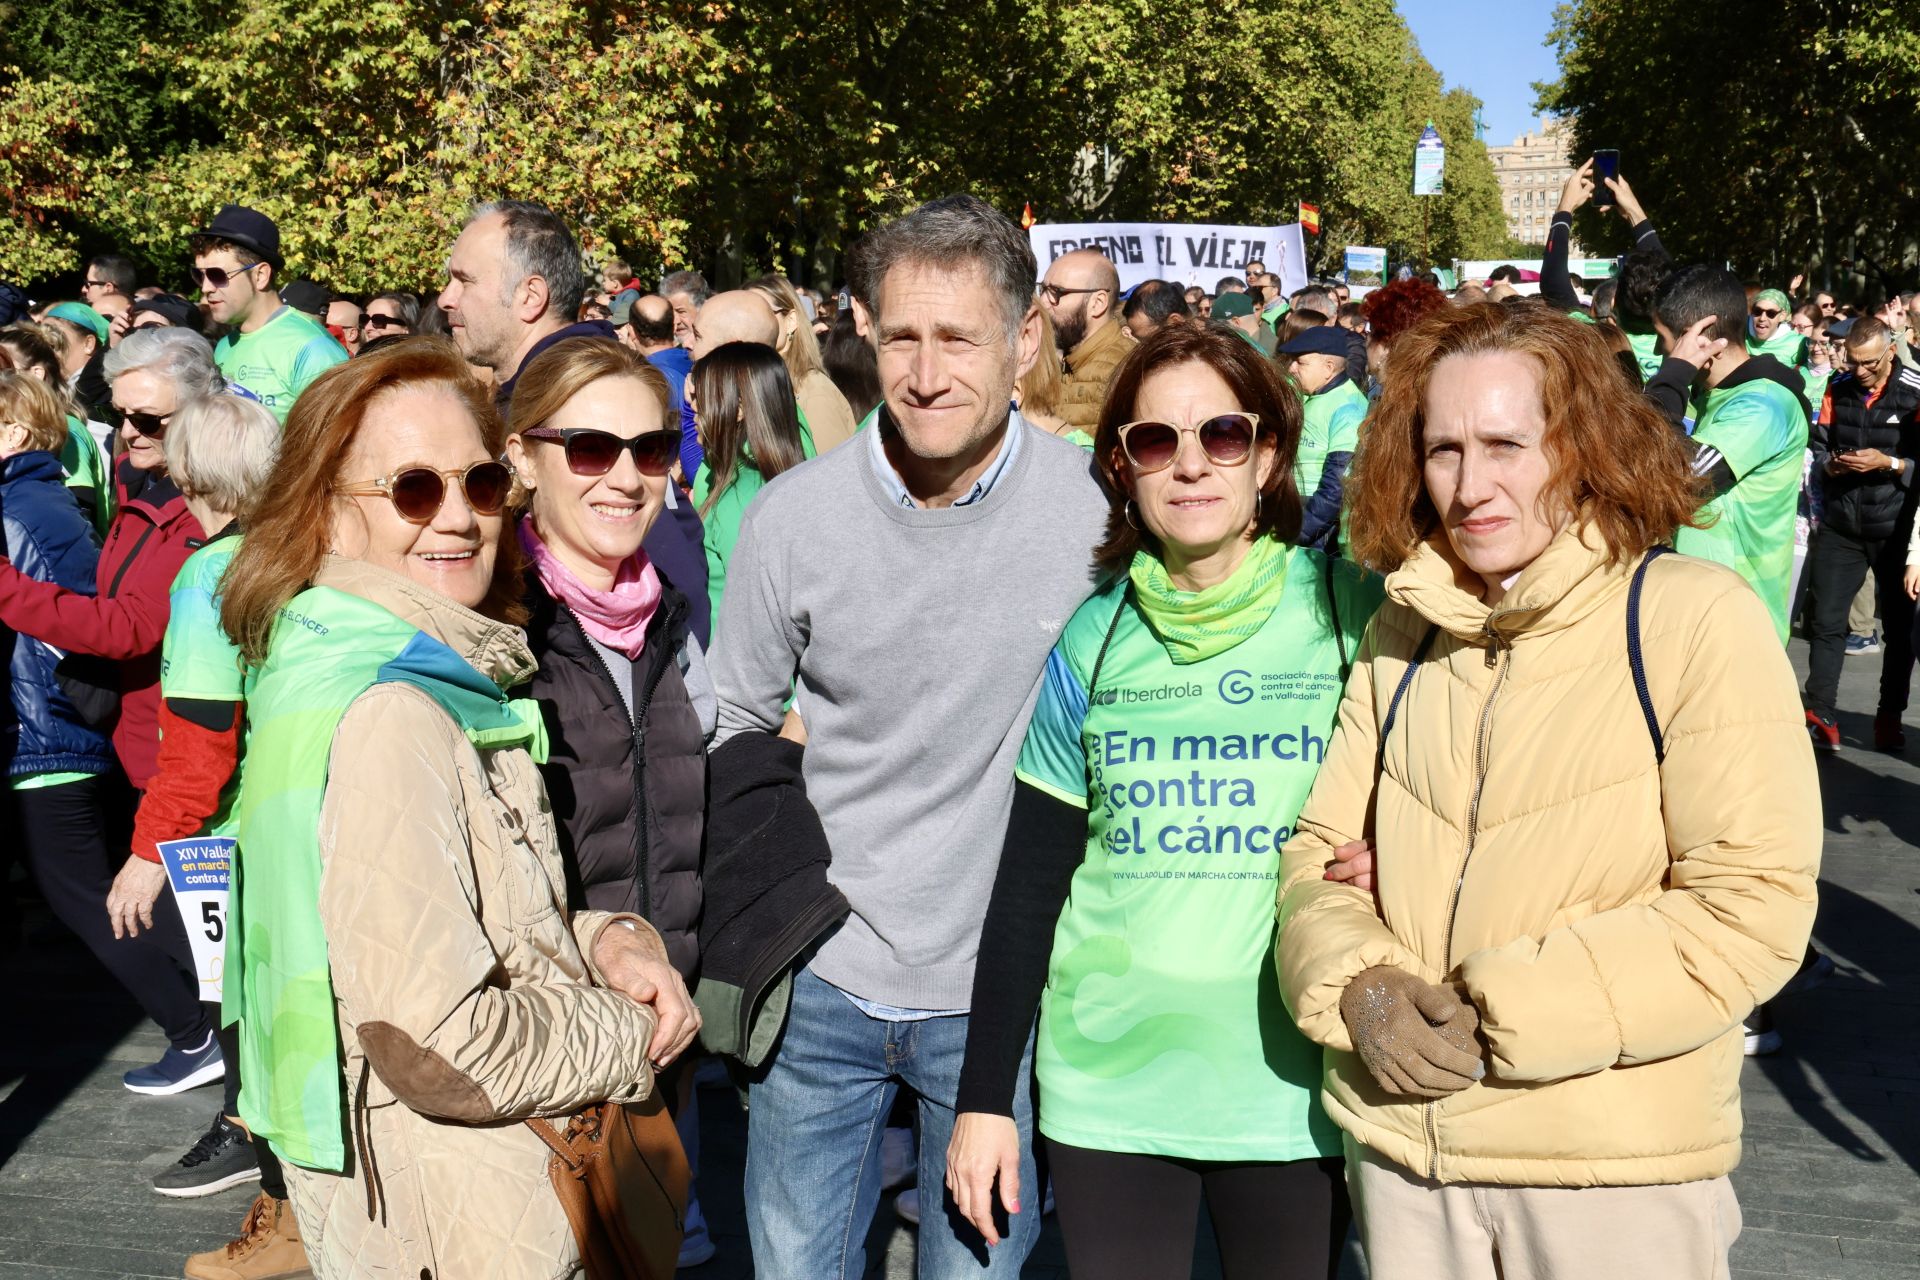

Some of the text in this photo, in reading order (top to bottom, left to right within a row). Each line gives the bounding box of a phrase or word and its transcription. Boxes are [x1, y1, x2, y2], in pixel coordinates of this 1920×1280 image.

[1152, 235, 1176, 266] EL
[1261, 671, 1311, 681] asociación
[1122, 682, 1202, 703] Iberdrola
[1261, 681, 1335, 691] contra el cáncer
[1275, 691, 1321, 700] Valladolid
[1104, 730, 1156, 767] En
[1109, 770, 1256, 810] contra
[1112, 816, 1146, 855] el
[176, 847, 198, 860] XIV
[182, 863, 197, 871] en
[186, 873, 218, 884] contra
[1113, 872, 1124, 880] XIV
[1125, 871, 1172, 879] VALLADOLID
[1187, 872, 1226, 880] MARCHA
[1227, 872, 1264, 880] CONTRA
[202, 901, 227, 943] 5
